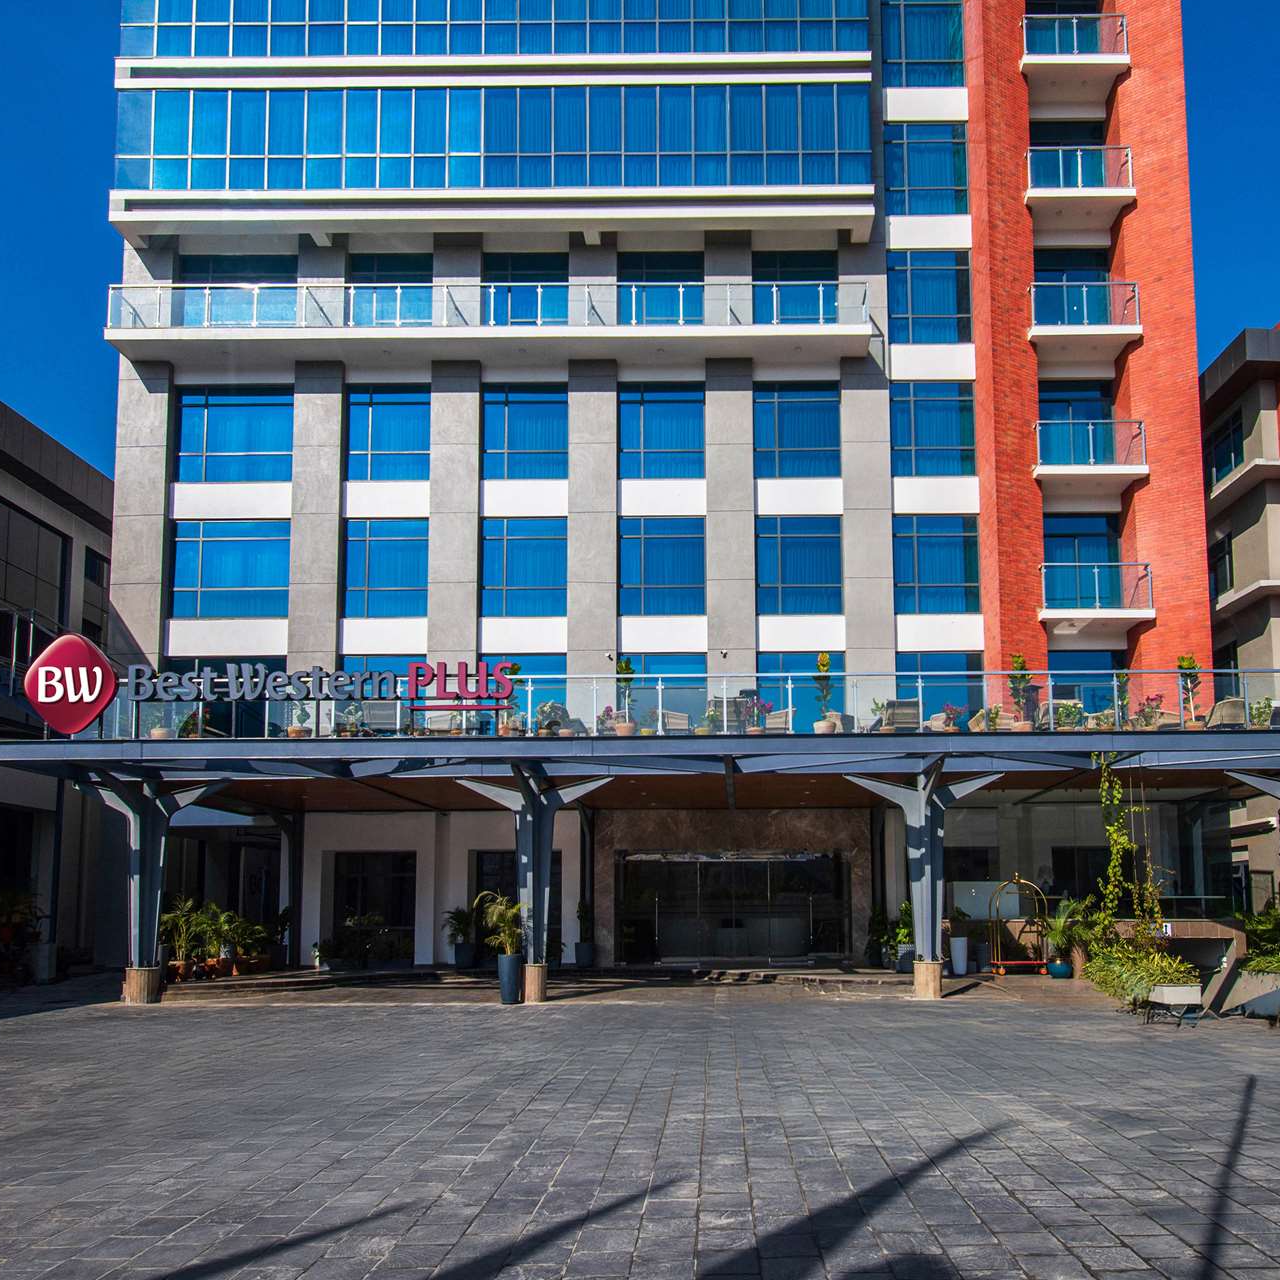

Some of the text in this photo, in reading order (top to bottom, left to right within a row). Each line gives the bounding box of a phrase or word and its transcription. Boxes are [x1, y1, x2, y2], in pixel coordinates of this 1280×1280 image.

[37, 665, 104, 704] BW
[127, 661, 515, 702] Best Western PLUS
